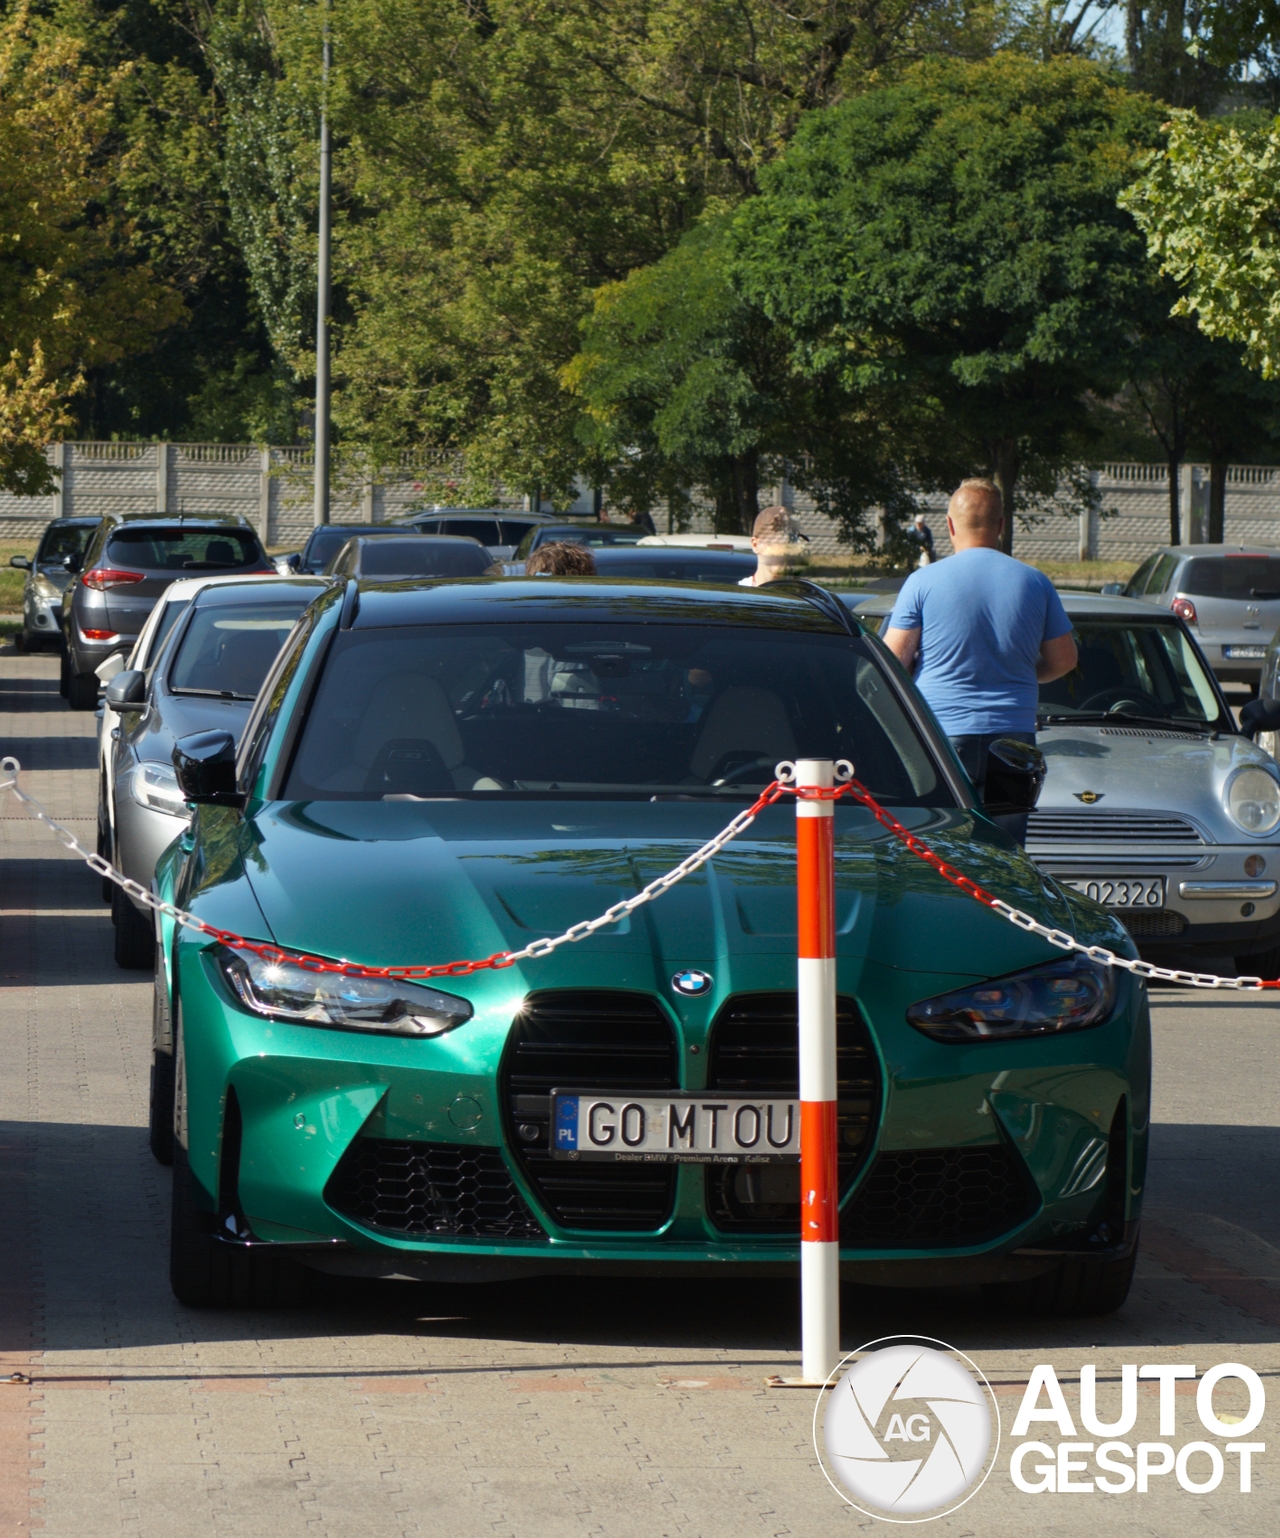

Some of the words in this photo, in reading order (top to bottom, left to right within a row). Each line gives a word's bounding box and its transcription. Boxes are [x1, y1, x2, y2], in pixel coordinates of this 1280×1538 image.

[1086, 881, 1159, 906] 02326
[558, 1128, 576, 1141] PL
[587, 1102, 646, 1147] GO
[668, 1104, 801, 1149] MTOU
[614, 1152, 643, 1161] Dealer
[644, 1153, 668, 1162] BMW
[673, 1154, 712, 1163] Premium
[713, 1154, 739, 1163] Arena
[744, 1154, 771, 1163] Kalisz
